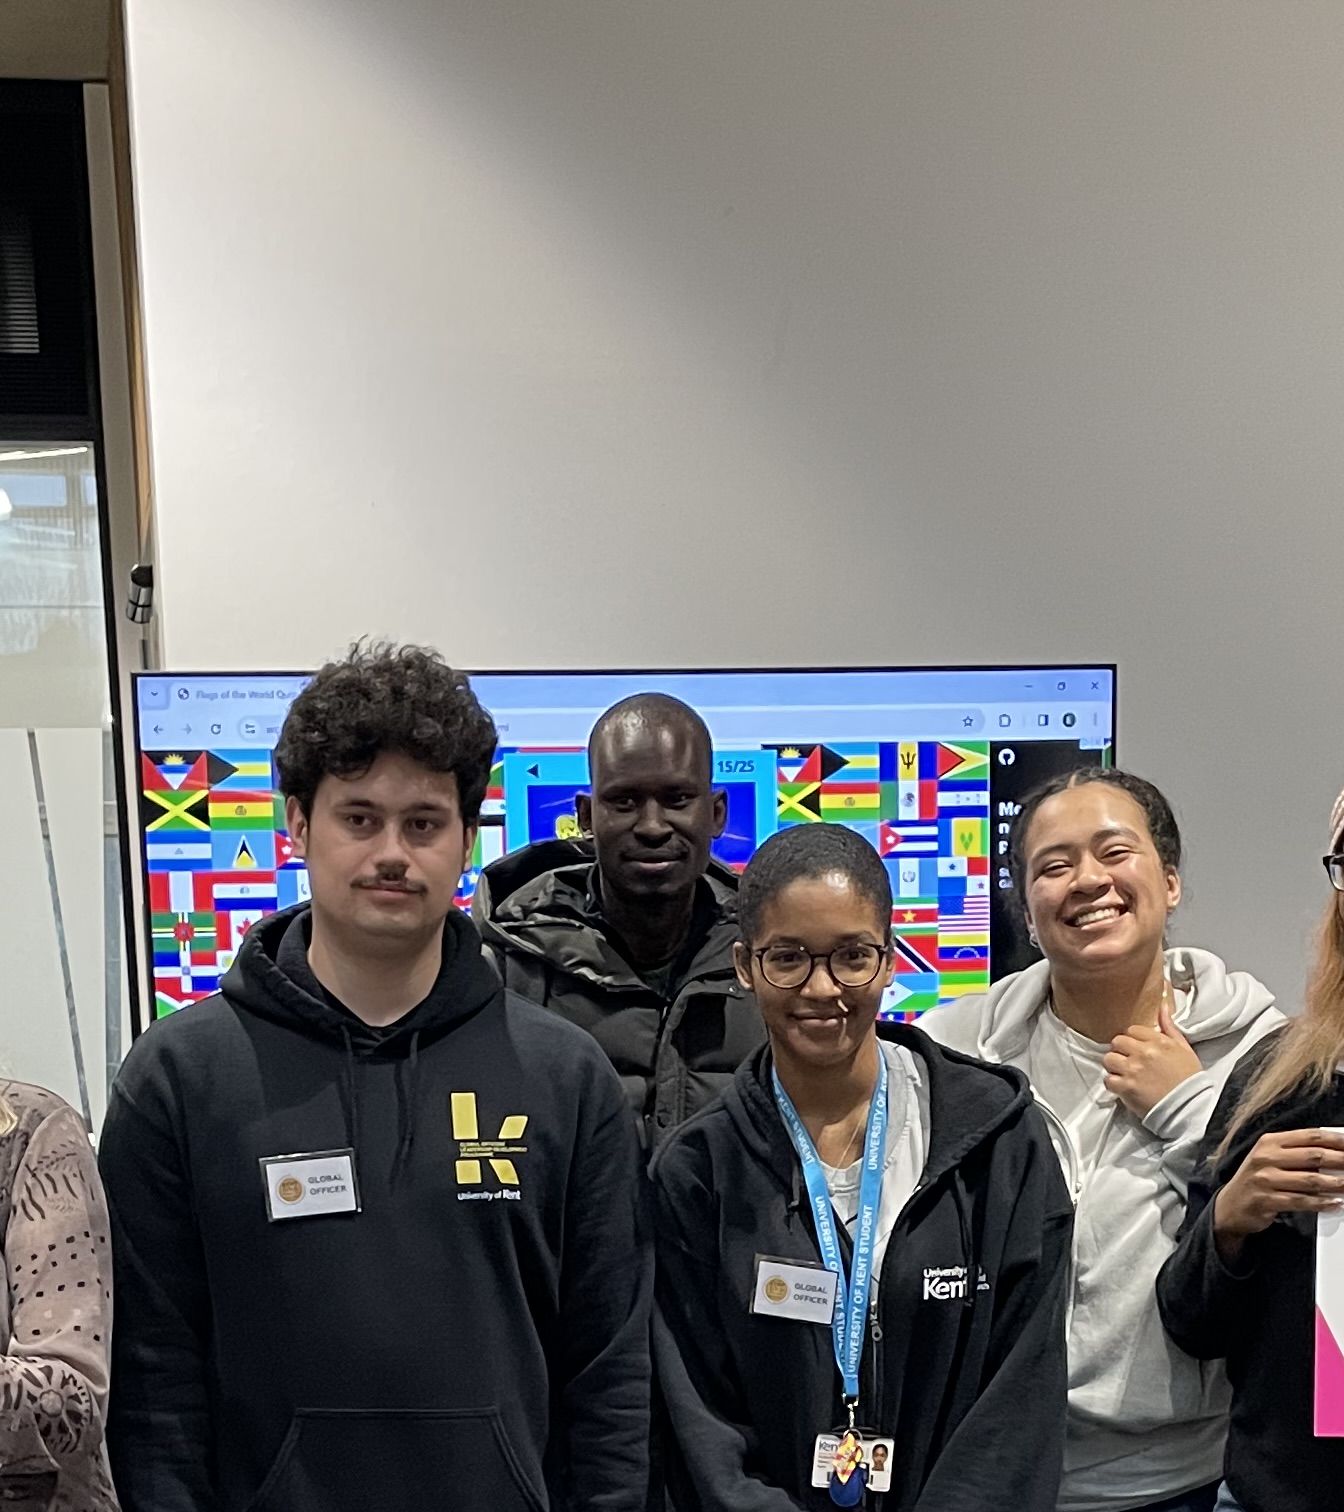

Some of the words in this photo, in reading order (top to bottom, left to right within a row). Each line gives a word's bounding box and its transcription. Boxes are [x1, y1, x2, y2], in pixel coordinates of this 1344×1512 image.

[717, 760, 755, 773] 15/25
[792, 1121, 816, 1165] STUDENT
[868, 1109, 884, 1170] UNIVERSITY
[308, 1174, 344, 1184] GLOBAL
[309, 1185, 347, 1195] OFFICER
[815, 1195, 838, 1259] UNIVERSITY
[858, 1205, 873, 1255] STUDENT
[856, 1257, 868, 1286] KENT
[793, 1294, 828, 1305] OFFICER
[794, 1283, 827, 1294] GLOBAL
[853, 1289, 863, 1304] OF
[847, 1307, 862, 1373] UNIVERSITY
